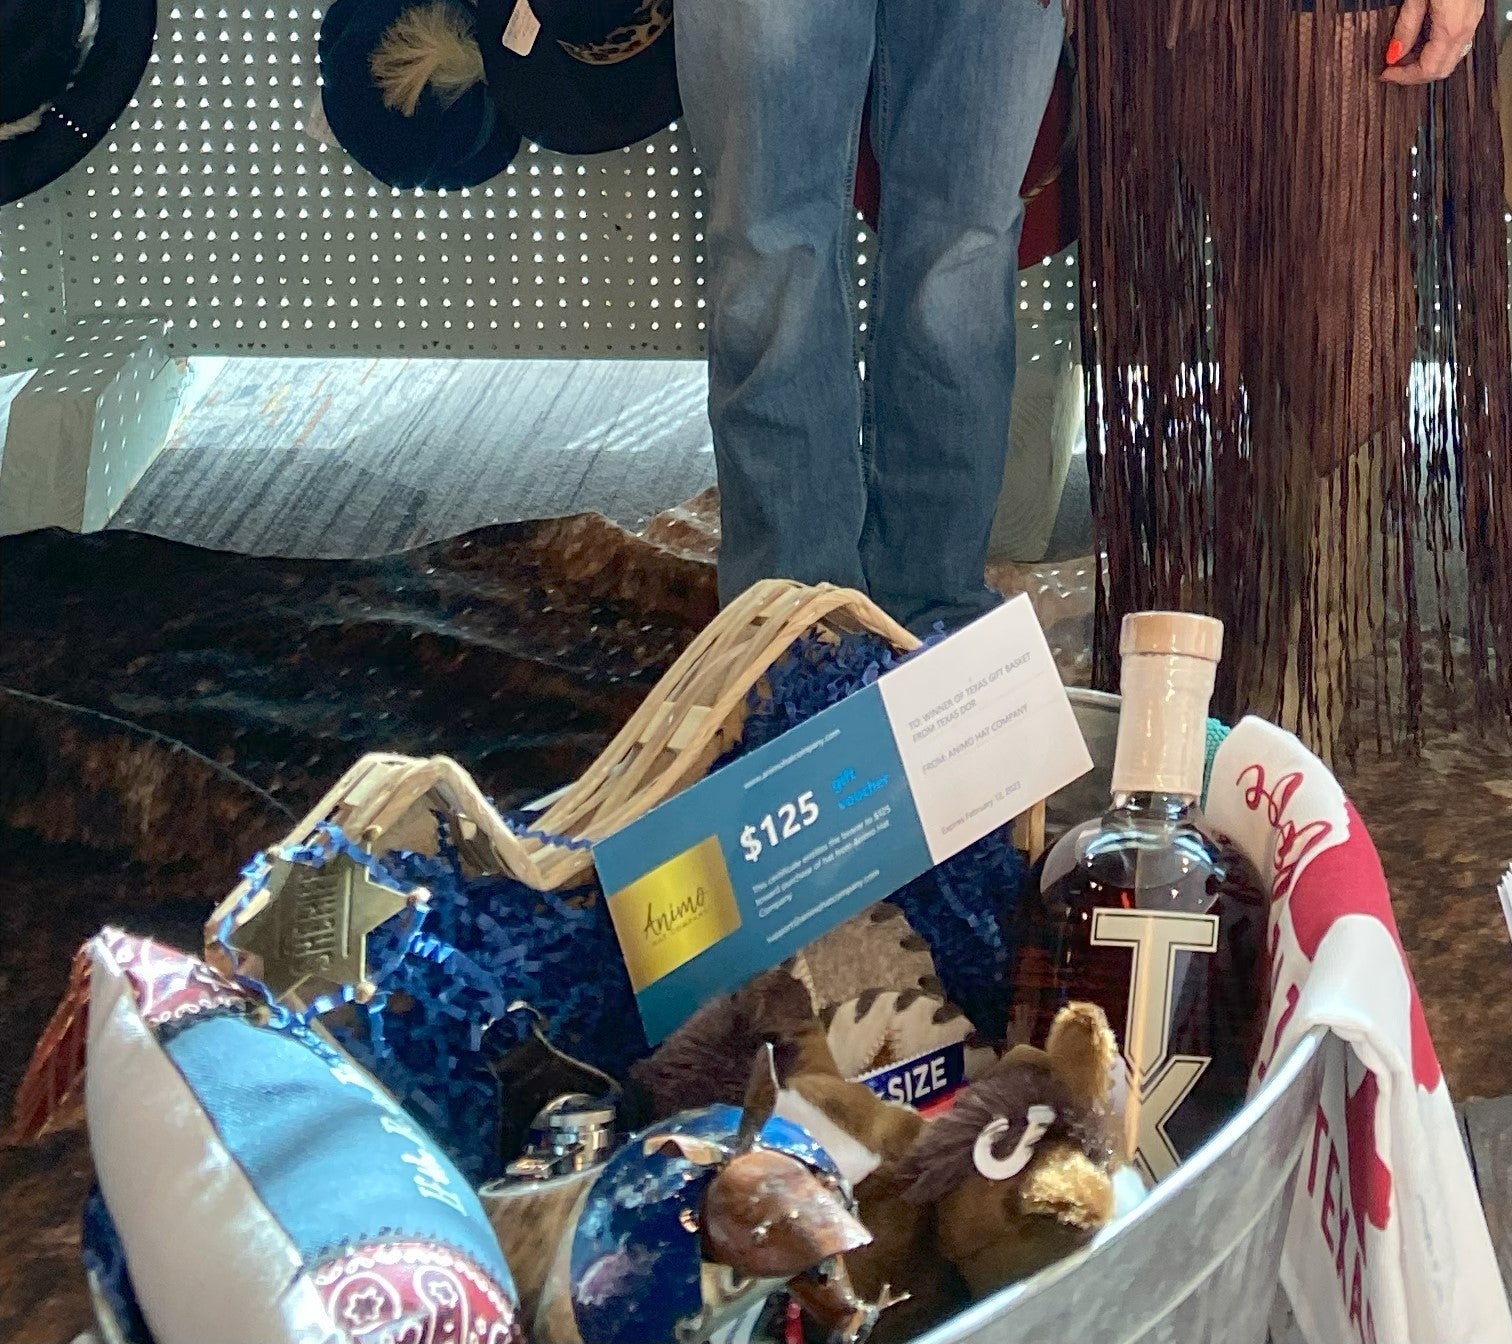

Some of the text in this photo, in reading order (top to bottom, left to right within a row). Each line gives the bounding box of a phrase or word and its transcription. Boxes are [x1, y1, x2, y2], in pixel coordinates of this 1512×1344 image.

[965, 678, 988, 696] TEXAS
[740, 791, 819, 862] $125
[644, 886, 708, 939] Animo
[886, 1056, 948, 1104] SIZE
